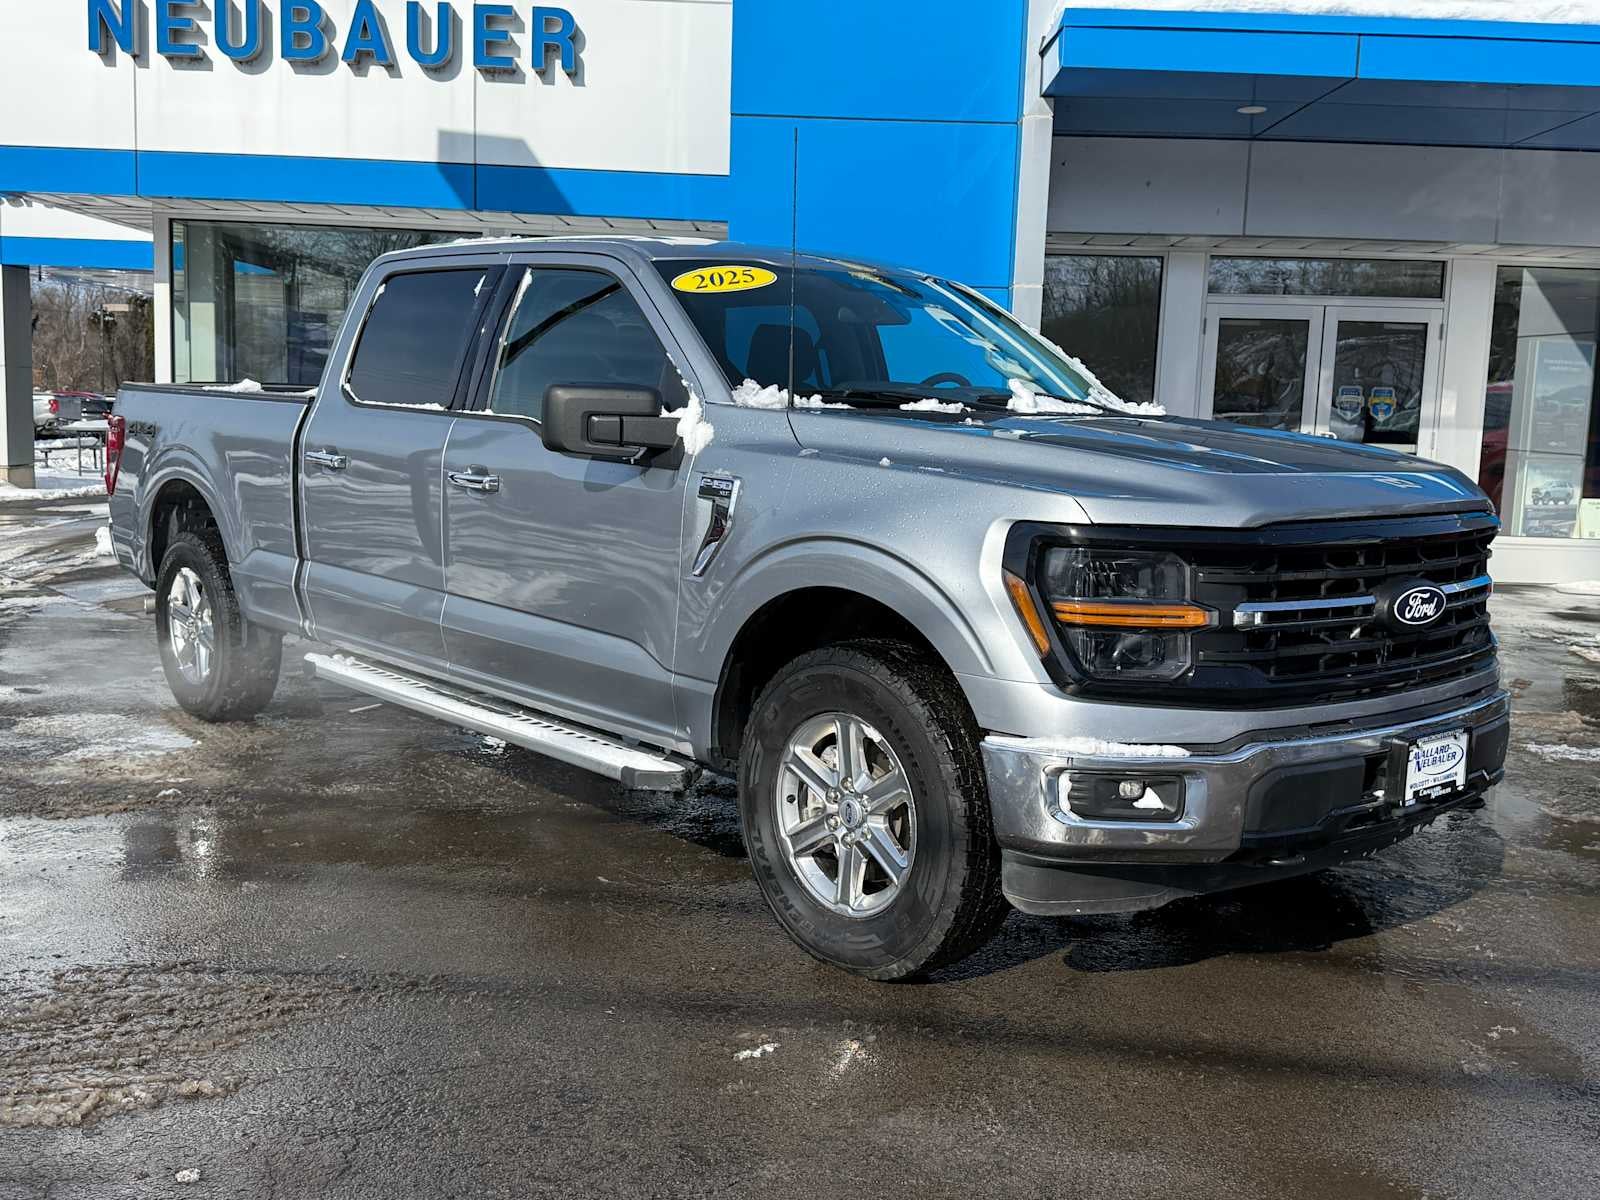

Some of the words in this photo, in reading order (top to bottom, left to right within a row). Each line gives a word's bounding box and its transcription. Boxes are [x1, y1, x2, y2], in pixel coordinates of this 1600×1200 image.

[88, 0, 577, 72] NEUBAUER
[692, 269, 755, 289] 2025
[1404, 592, 1438, 619] Ford
